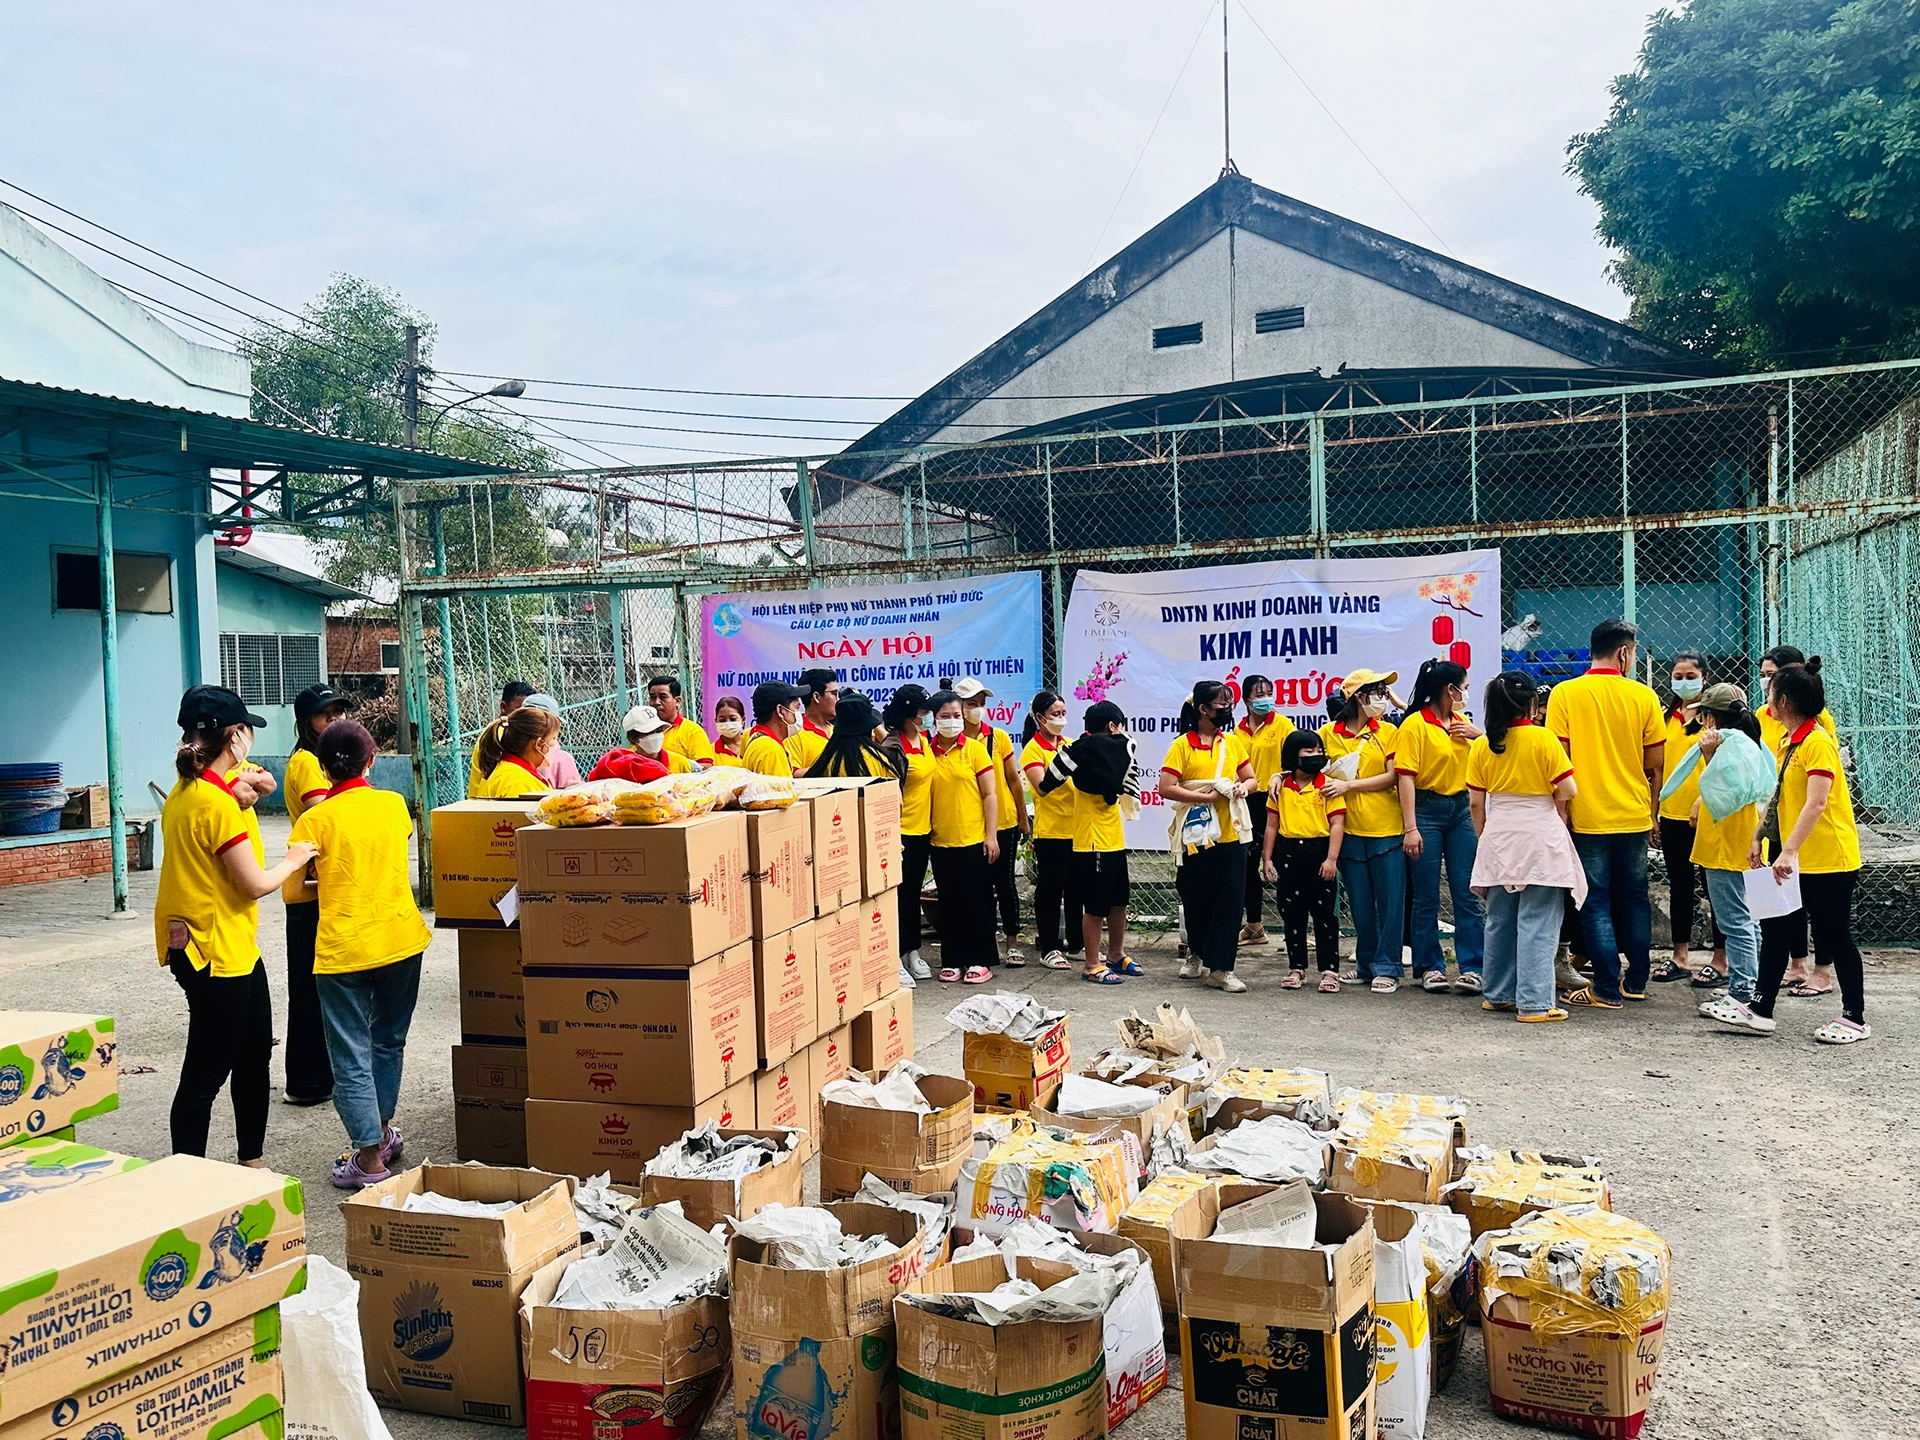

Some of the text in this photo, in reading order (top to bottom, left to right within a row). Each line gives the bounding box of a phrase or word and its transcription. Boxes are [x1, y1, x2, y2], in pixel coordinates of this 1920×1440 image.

[752, 590, 984, 618] HỘI LIÊN HIỆP PHỤ NỮ THÀNH PHỐ THỦ ĐỨC
[1160, 592, 1380, 623] DNTN KINH DOANH VÀNG
[790, 611, 940, 631] CÂU LẠC BỘ NỮ DOANH NHÂN
[798, 630, 934, 661] NGÀY HỘI
[1200, 626, 1338, 663] KIM HẠNH
[718, 670, 735, 687] NỮ
[851, 664, 885, 682] CÔNG
[890, 662, 914, 680] TÁC
[917, 661, 934, 679] XÃ
[939, 659, 960, 680] HỘI
[964, 657, 983, 676] TỪ
[986, 656, 1024, 678] THIỆN
[585, 1062, 618, 1071] KINH DO
[598, 1137, 633, 1147] KINH DO
[9, 1288, 132, 1352] LOTHAMILK
[393, 1308, 454, 1350] Sunlight
[53, 1328, 82, 1350] LONG
[86, 1318, 181, 1370] LOTHAMILK
[11, 1341, 50, 1368] THÀNH
[1508, 1352, 1606, 1379] HƯƠNG VIỆT
[88, 1356, 184, 1408] LOTHAMILK
[184, 1371, 210, 1394] LONG
[213, 1357, 245, 1380] THÀNH
[1064, 1383, 1082, 1394] CHO
[137, 1371, 246, 1434] LOTHAMILK
[1018, 1394, 1044, 1407] KHỎE
[1046, 1388, 1064, 1401] SỨC
[760, 1403, 807, 1440] laVie
[1504, 1403, 1584, 1431] THANH
